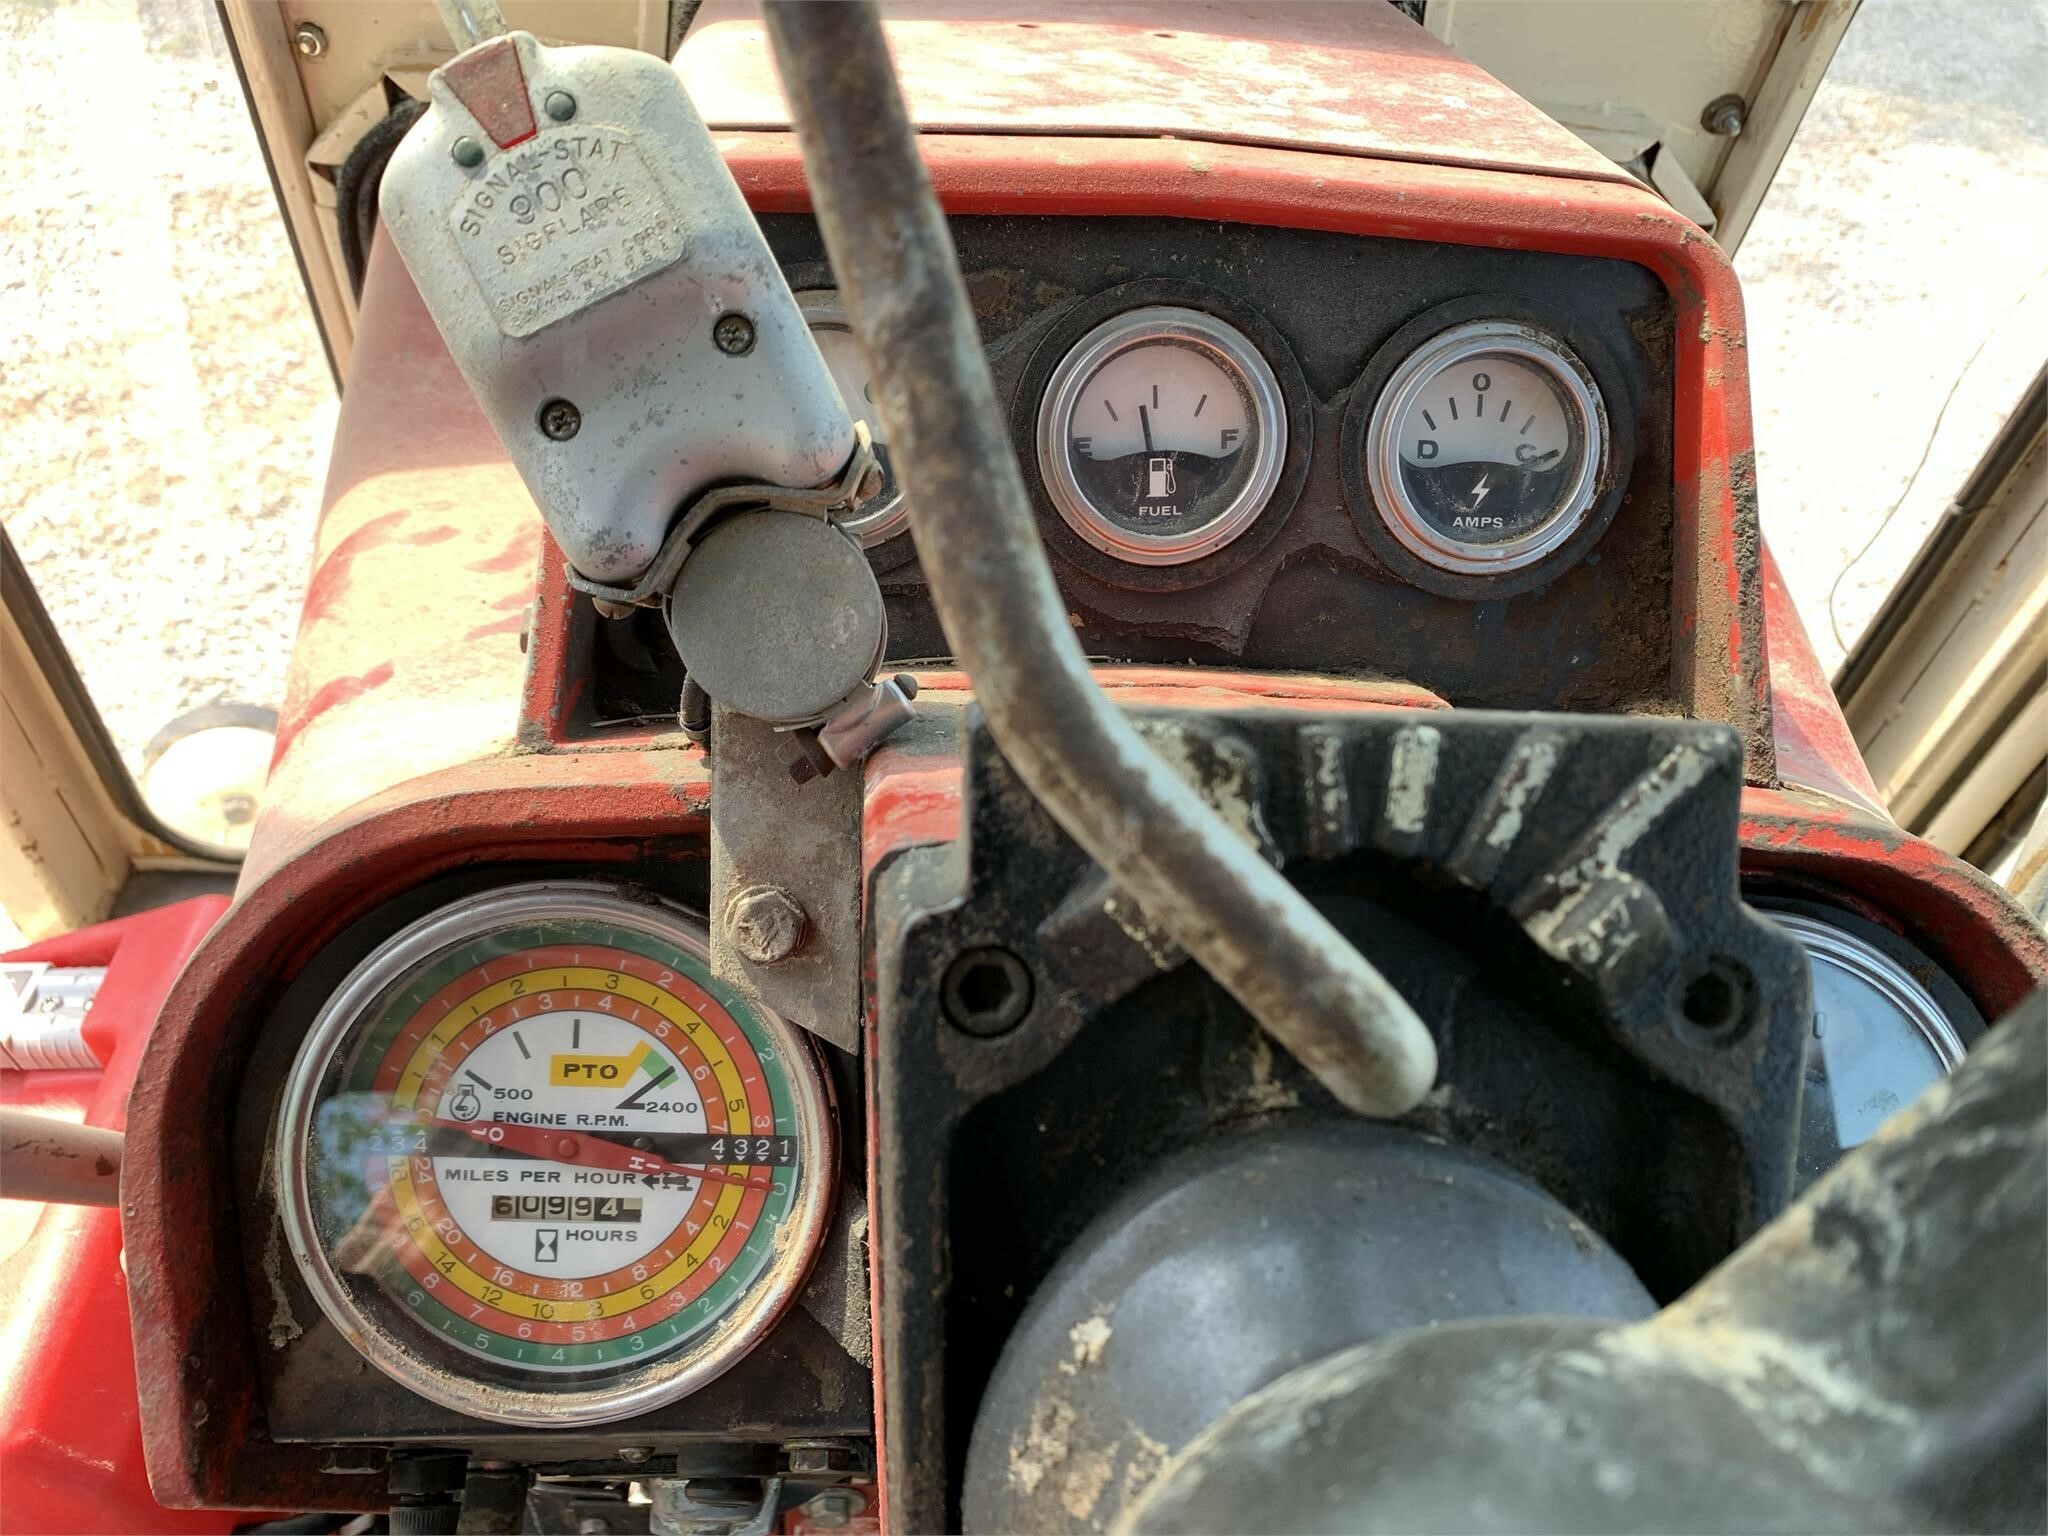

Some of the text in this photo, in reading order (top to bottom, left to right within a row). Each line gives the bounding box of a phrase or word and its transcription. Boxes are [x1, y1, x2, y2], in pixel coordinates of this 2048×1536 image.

[460, 136, 627, 237] SIGNAL-STAT
[509, 167, 588, 225] 900
[1074, 429, 1239, 457] E F
[1417, 439, 1537, 463] D C
[1138, 505, 1183, 517] FUEL
[1452, 516, 1504, 528] AMPS
[479, 1018, 497, 1035] 2
[538, 994, 553, 1010] 3
[597, 995, 613, 1011] 4
[655, 1021, 673, 1038] 5
[694, 1065, 711, 1081] 6
[509, 979, 526, 996] 2
[604, 974, 620, 990] 3
[685, 1021, 702, 1036] 4
[728, 1098, 745, 1113] 5
[656, 971, 675, 989] 2
[754, 1114, 771, 1129] 3
[758, 1047, 775, 1064] 2
[563, 1063, 619, 1080] PTO
[493, 1088, 698, 1114] 500 2400
[492, 1111, 630, 1128] ENGINE R.P.M.
[413, 1136, 429, 1153] 4
[710, 1138, 789, 1156] 4 3 2 1
[444, 1168, 637, 1186] MILES PER HOUR
[564, 1229, 639, 1243] HOURS
[436, 1217, 462, 1245] 20
[492, 1266, 514, 1287] 16
[631, 1264, 648, 1281] 8
[685, 1221, 701, 1237] 4
[434, 1251, 457, 1274] 14
[481, 1286, 503, 1306] 12
[532, 1303, 554, 1320] 10
[639, 1285, 656, 1301] 6
[684, 1253, 700, 1269] 4
[712, 1214, 730, 1231] 2
[422, 1272, 441, 1289] 8
[468, 1303, 485, 1320] 7
[517, 1322, 533, 1339] 6
[572, 1325, 586, 1342] 5
[622, 1315, 637, 1331] 4
[669, 1290, 686, 1309] 3
[708, 1256, 727, 1274] 2
[407, 1290, 425, 1307] 6
[474, 1332, 490, 1350] 5
[551, 1347, 566, 1362] 4
[629, 1335, 645, 1351] 3
[697, 1297, 714, 1314] 2
